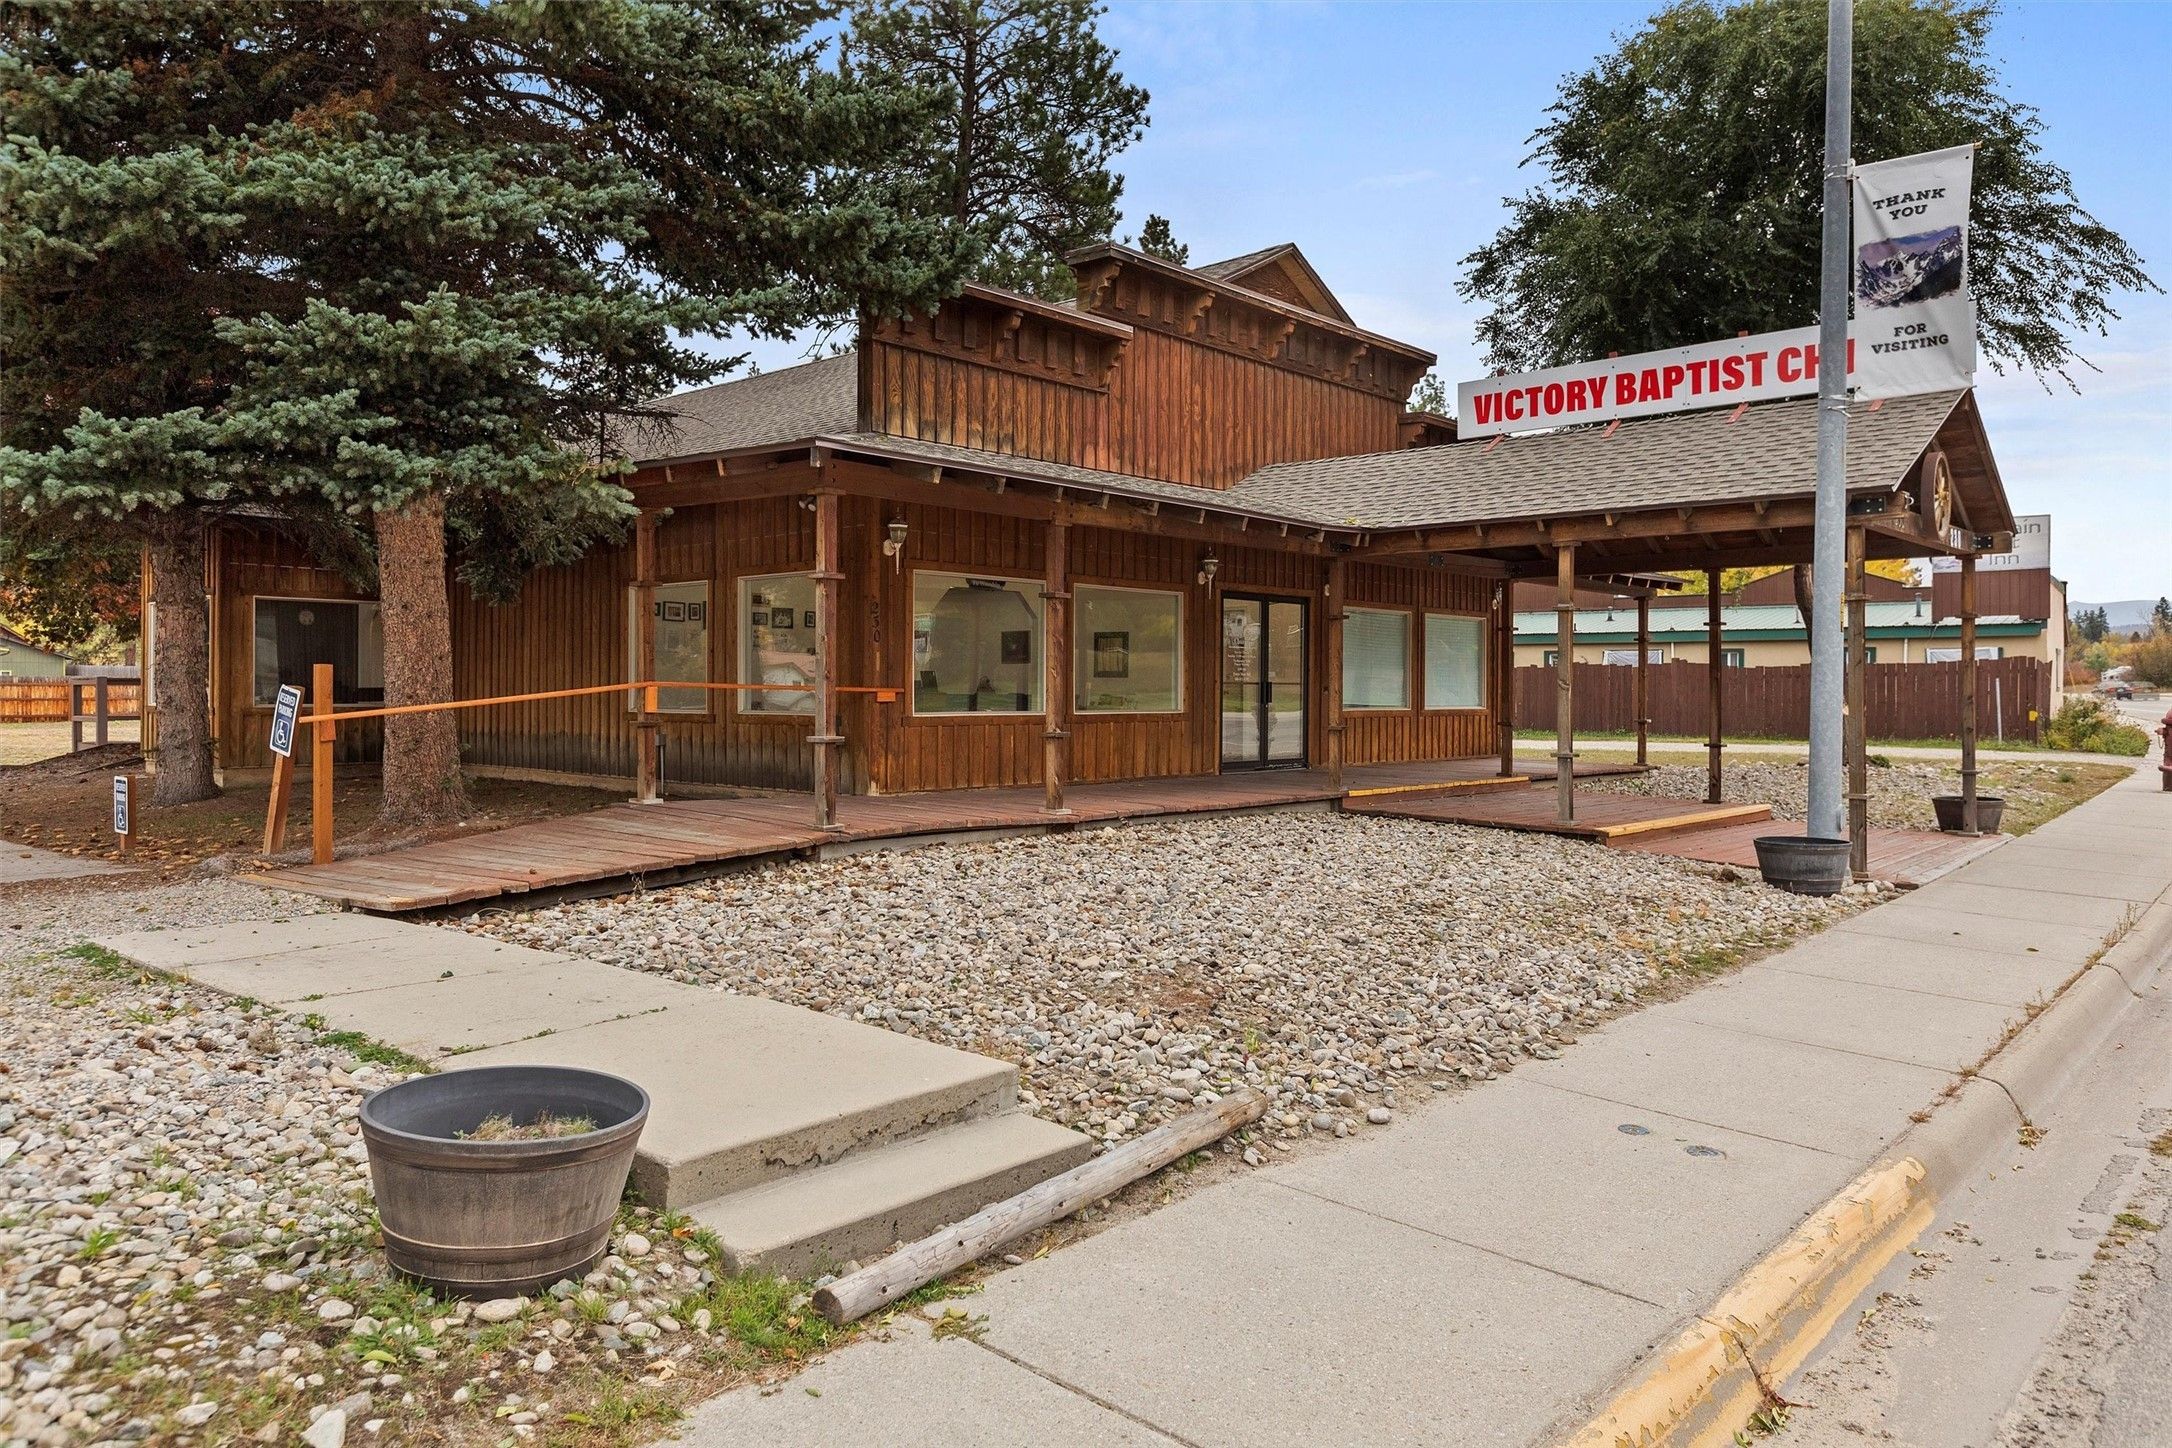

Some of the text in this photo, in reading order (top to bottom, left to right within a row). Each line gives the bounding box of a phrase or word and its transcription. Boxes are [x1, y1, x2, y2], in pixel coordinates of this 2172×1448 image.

[1872, 188, 1947, 210] THANK
[1889, 204, 1928, 221] YOU
[1894, 323, 1928, 338] FOR
[1871, 334, 1949, 355] VISITING
[1473, 375, 1608, 425] VICTORY
[1615, 351, 1768, 406] BAPTIST
[1989, 553, 2020, 566] Inn
